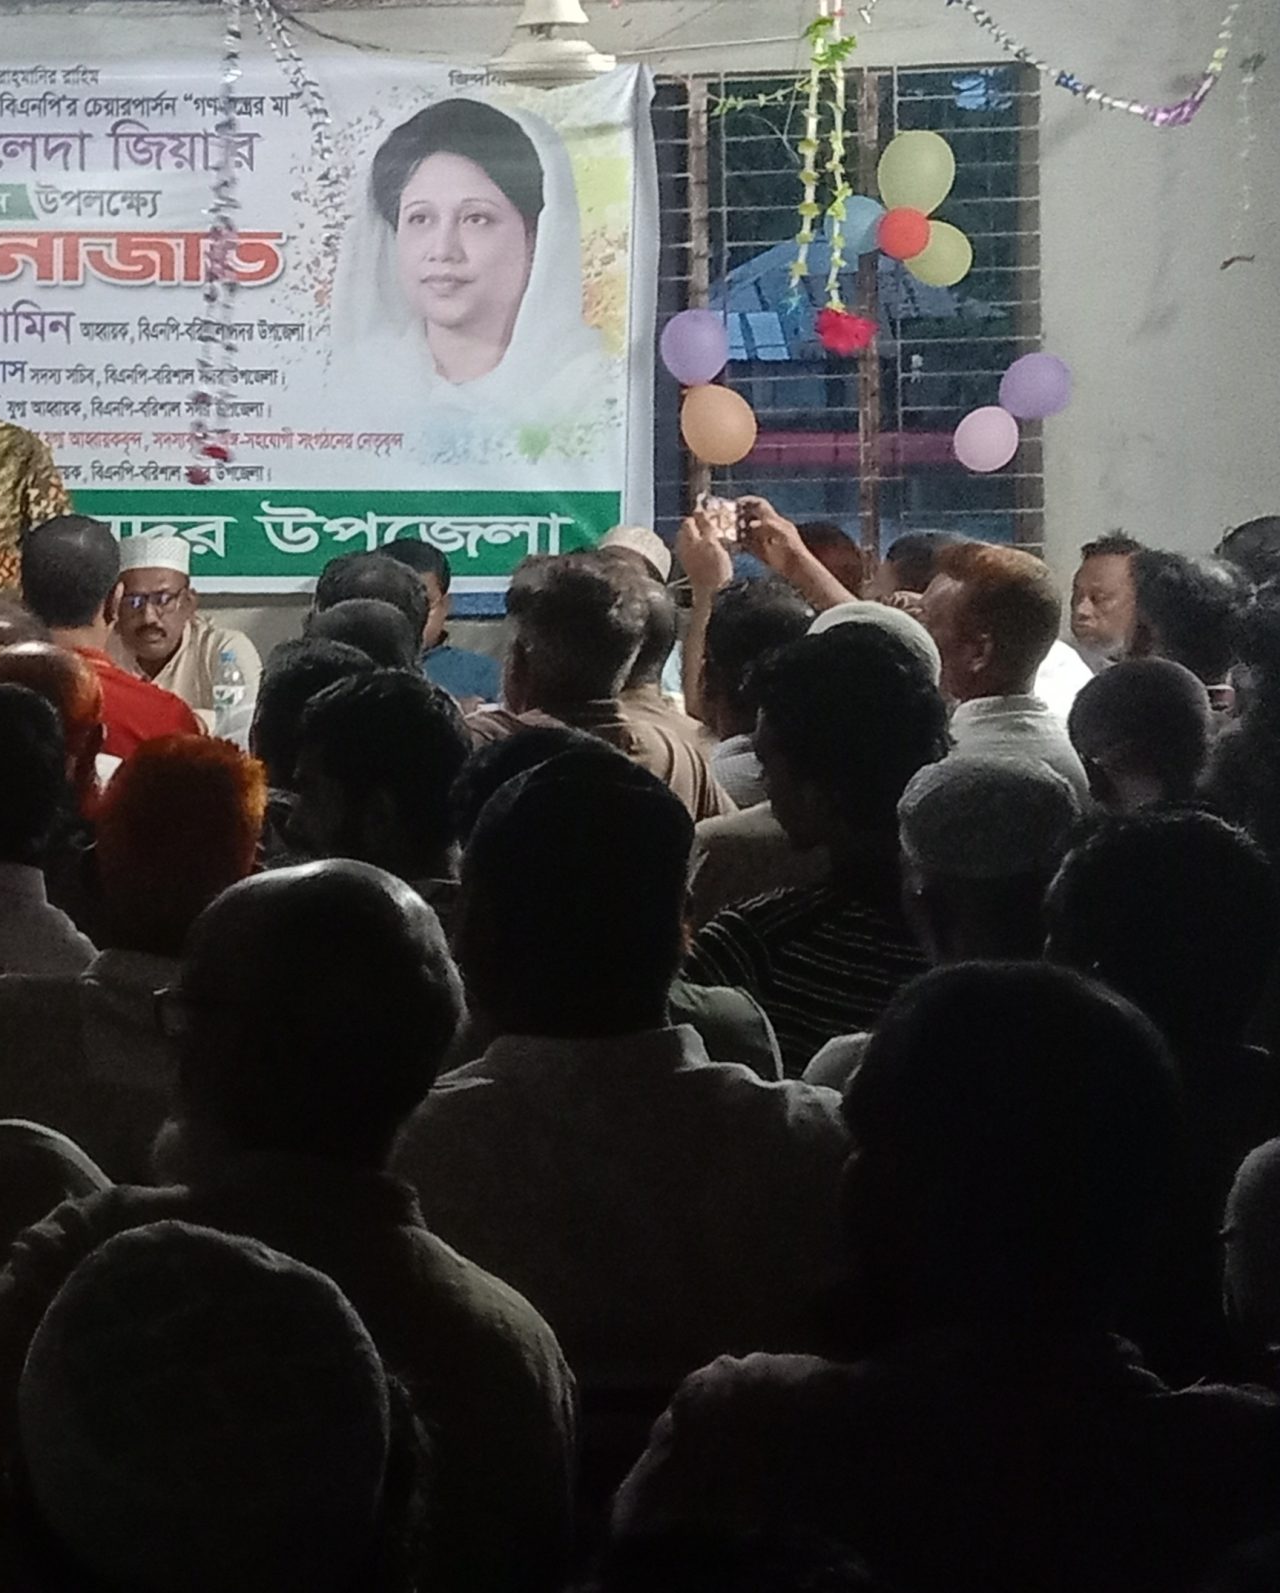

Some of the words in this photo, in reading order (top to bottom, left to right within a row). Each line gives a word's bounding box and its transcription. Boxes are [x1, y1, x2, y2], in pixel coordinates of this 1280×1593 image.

[84, 90, 178, 118] চেয়ারপার্সন
[34, 182, 162, 219] উপলক্ষ্যে
[29, 367, 63, 386] সদস্য
[88, 515, 239, 558] দর
